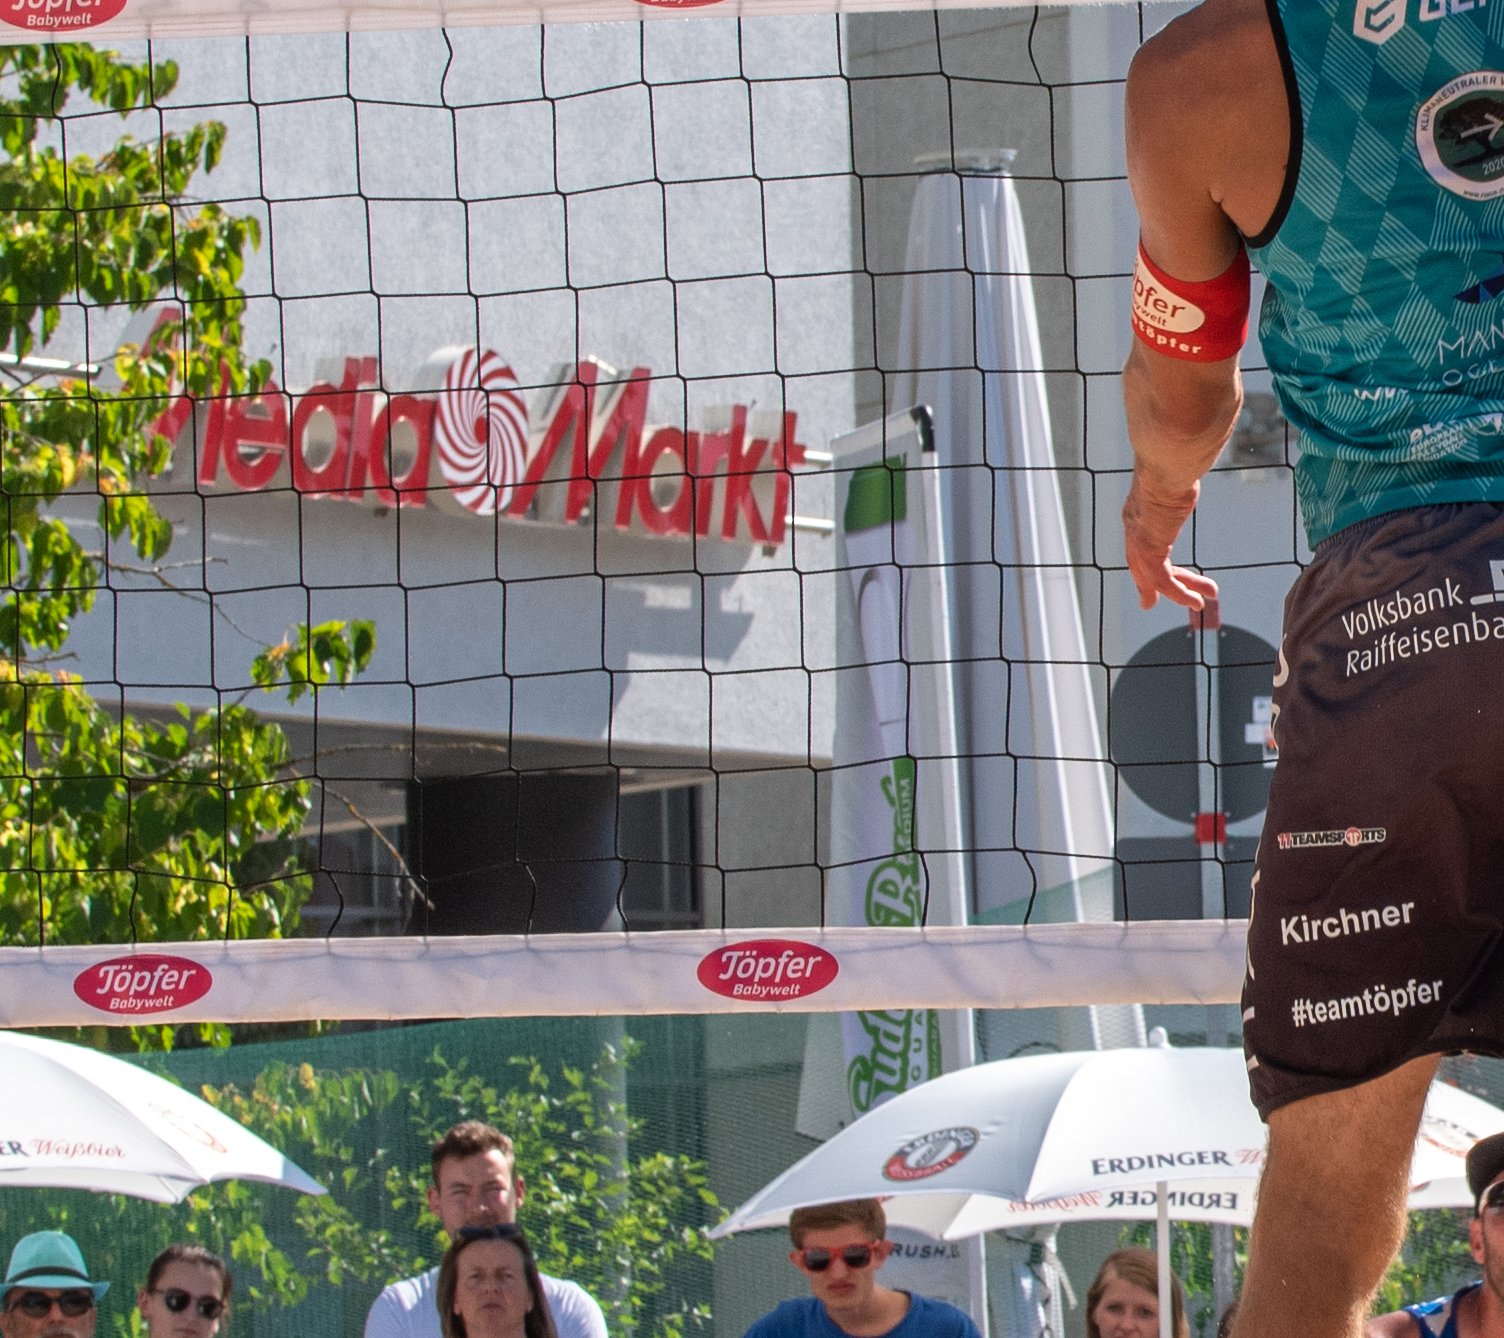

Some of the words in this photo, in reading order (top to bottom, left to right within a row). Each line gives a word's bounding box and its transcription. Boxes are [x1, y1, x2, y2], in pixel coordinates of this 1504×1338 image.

[27, 13, 91, 28] Babywelt
[507, 355, 804, 546] Markt
[1341, 578, 1464, 642] Volksbank
[1279, 900, 1416, 947] Kirchner
[97, 963, 196, 996] Töpfer
[719, 949, 822, 983] Töpfer
[110, 996, 173, 1009] Babywelt
[733, 983, 800, 996] Babywelt
[1291, 975, 1445, 1029] #teamtöpfer
[30, 1136, 127, 1160] Weißbier
[1091, 1148, 1232, 1177] ERDINGER
